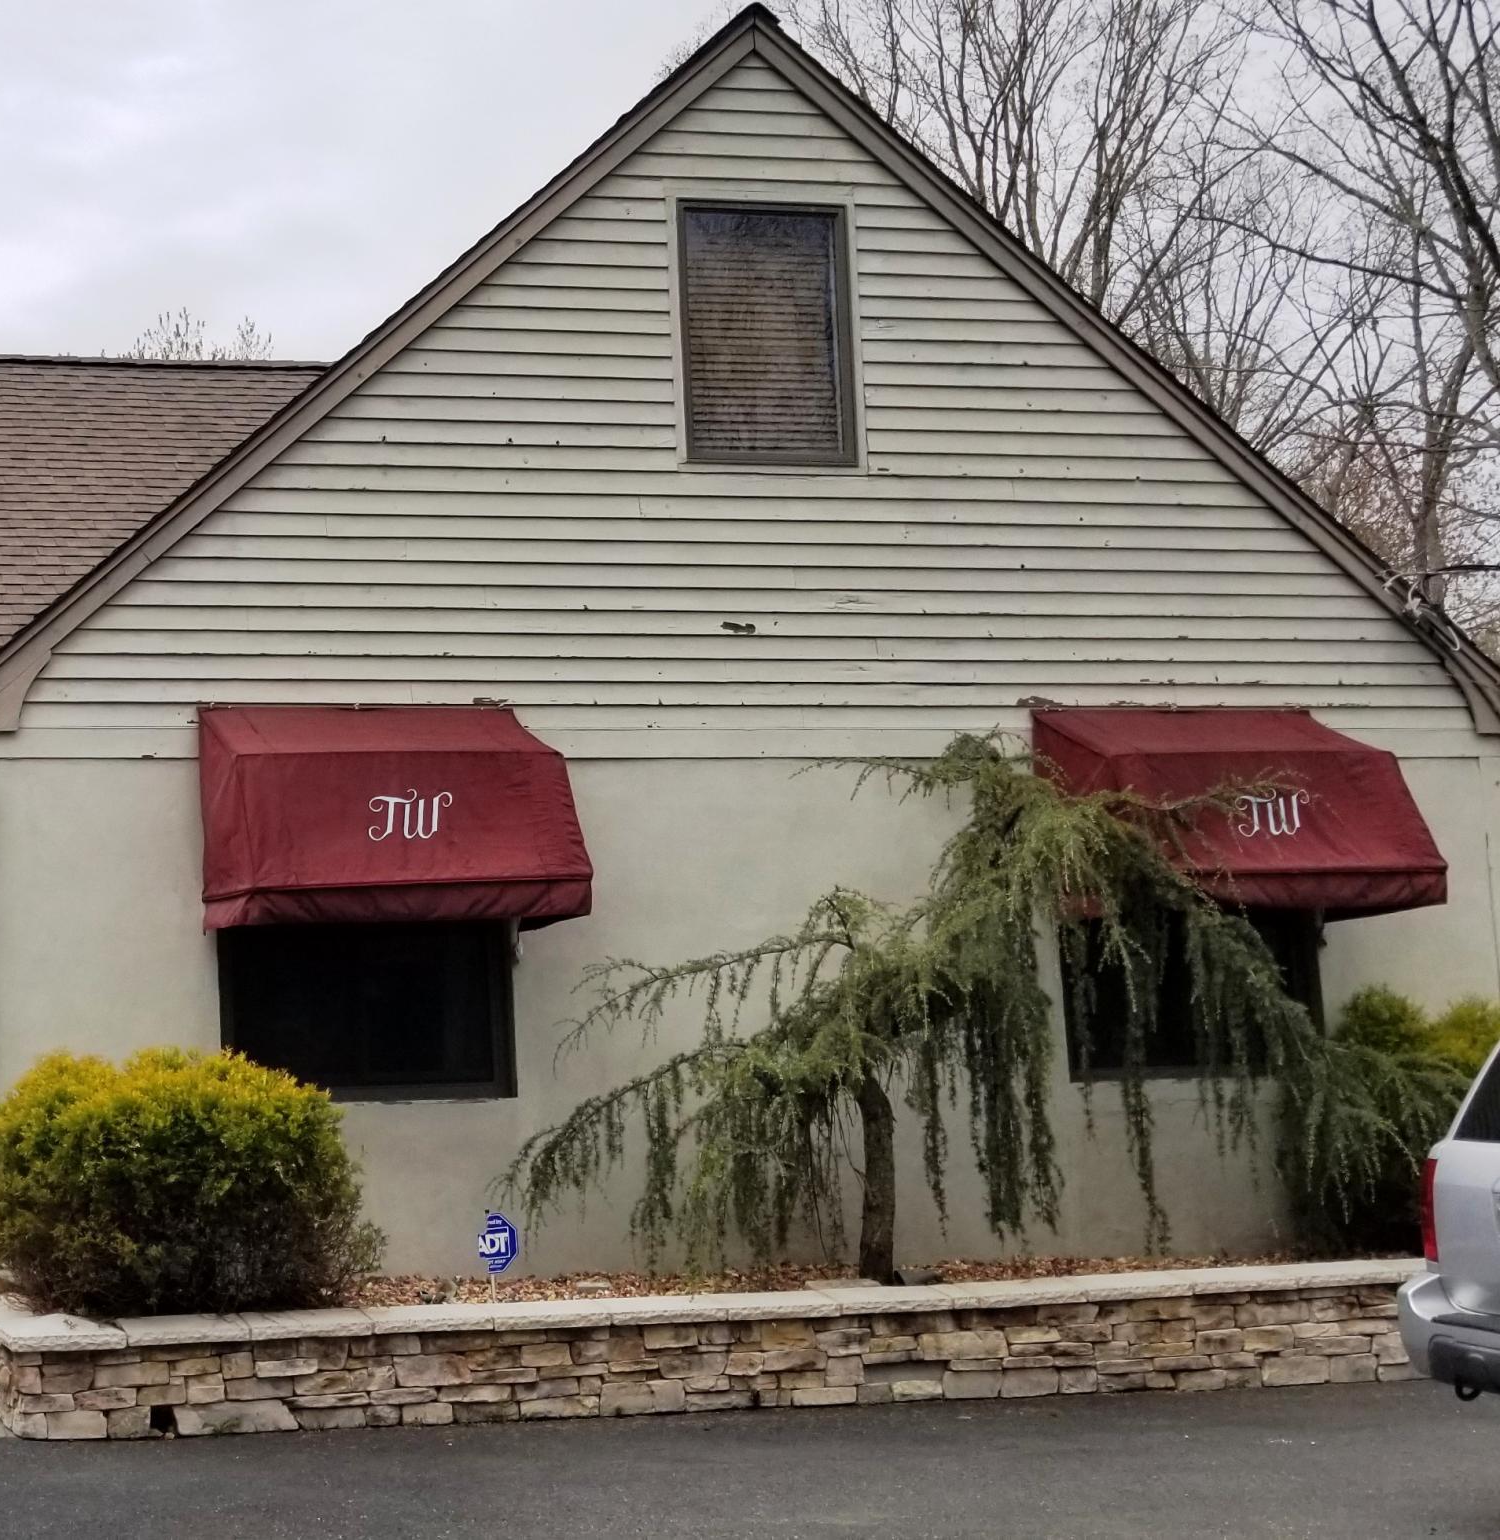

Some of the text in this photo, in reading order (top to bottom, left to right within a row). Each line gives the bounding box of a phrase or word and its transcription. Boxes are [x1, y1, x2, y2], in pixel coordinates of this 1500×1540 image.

[368, 788, 453, 841] TW
[1235, 788, 1310, 838] TW
[478, 1232, 508, 1254] ADT
